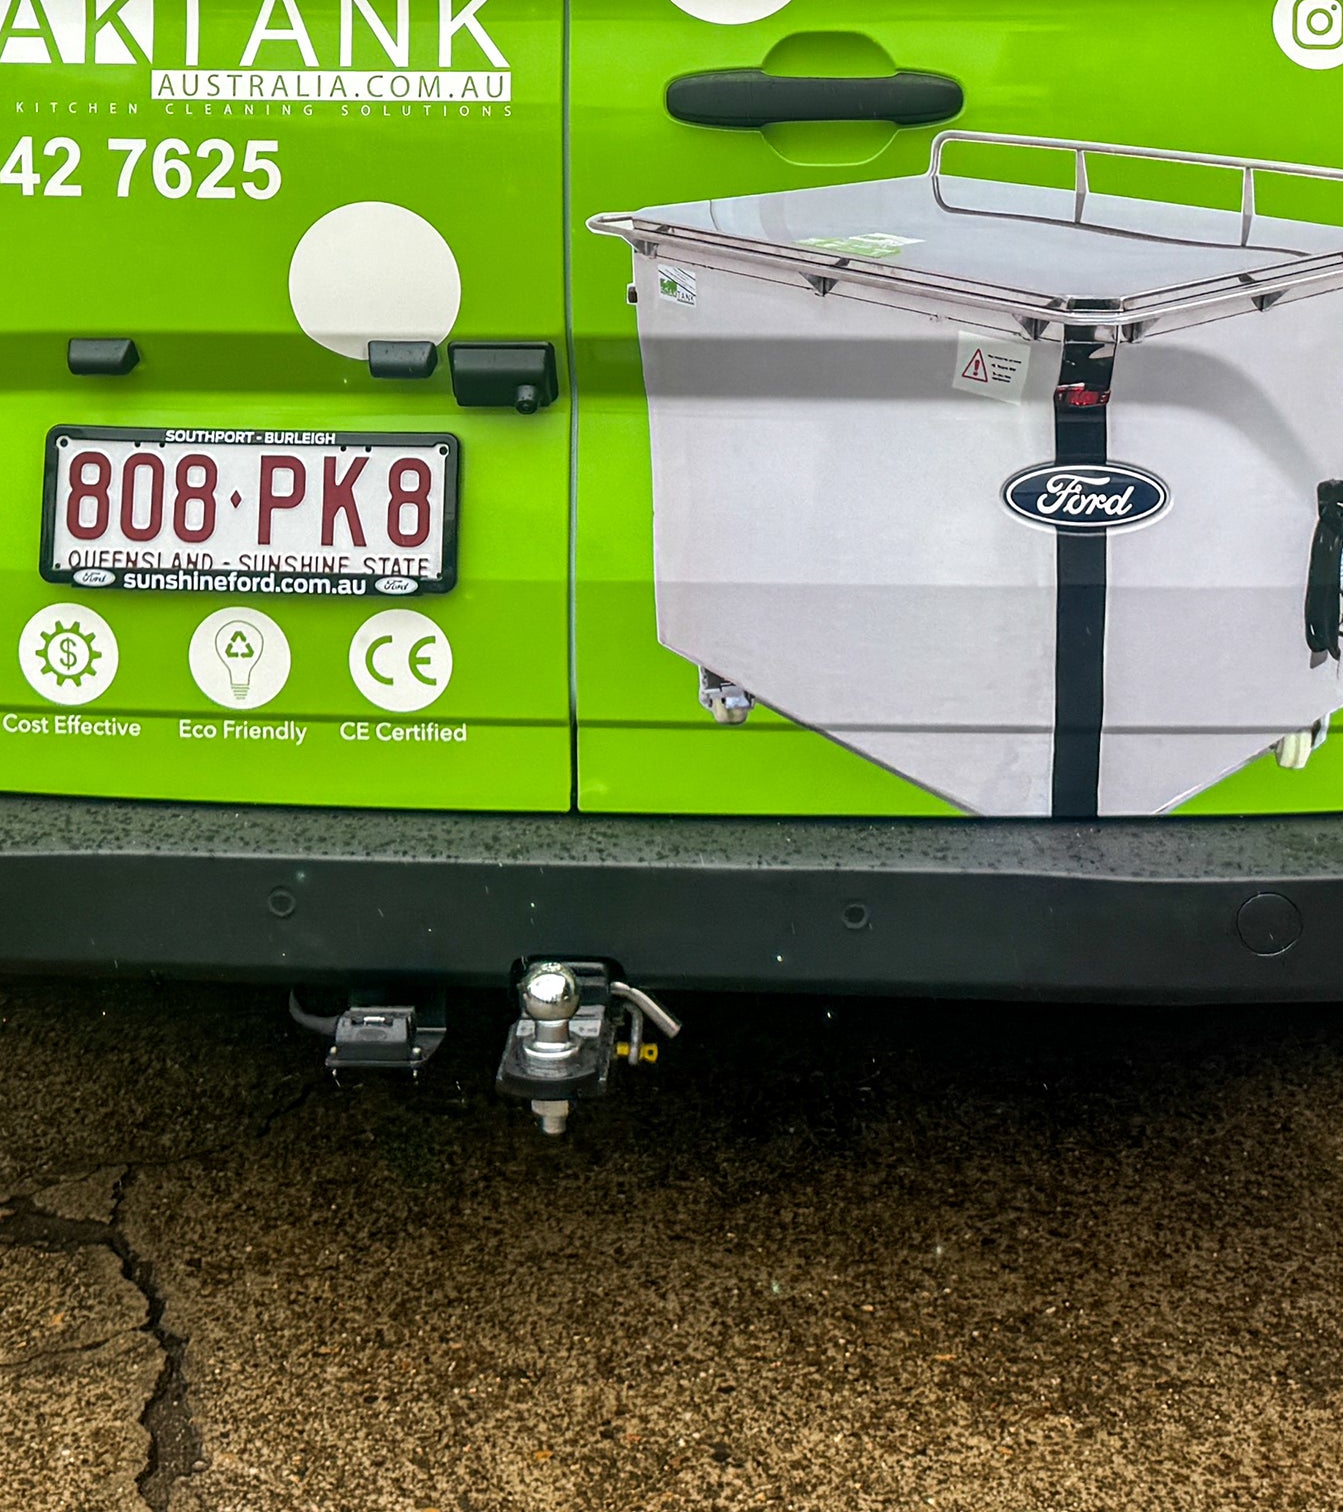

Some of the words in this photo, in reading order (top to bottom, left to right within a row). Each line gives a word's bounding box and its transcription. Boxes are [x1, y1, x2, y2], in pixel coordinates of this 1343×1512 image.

[158, 74, 505, 99] AUSTRALIA.COM.AU
[16, 101, 139, 114] KITCHEN
[165, 103, 314, 116] CLEANING
[341, 105, 513, 118] SOLUTIONS
[0, 136, 83, 197] 42
[107, 138, 282, 201] 7625
[165, 430, 254, 444] SOUTHPORT
[264, 432, 336, 445] BURLEIGH
[1036, 474, 1135, 515] Ford
[68, 550, 213, 571] QUEENSLAND
[239, 554, 350, 574] SUNSHINE
[363, 557, 430, 576] STATE
[123, 571, 367, 596] sunshineford.com.au
[2, 714, 49, 734] Cost
[54, 716, 142, 736] Effective
[179, 721, 217, 739] Eco
[223, 721, 307, 746] Friendly
[340, 723, 369, 740] CE
[376, 723, 467, 742] Certified
